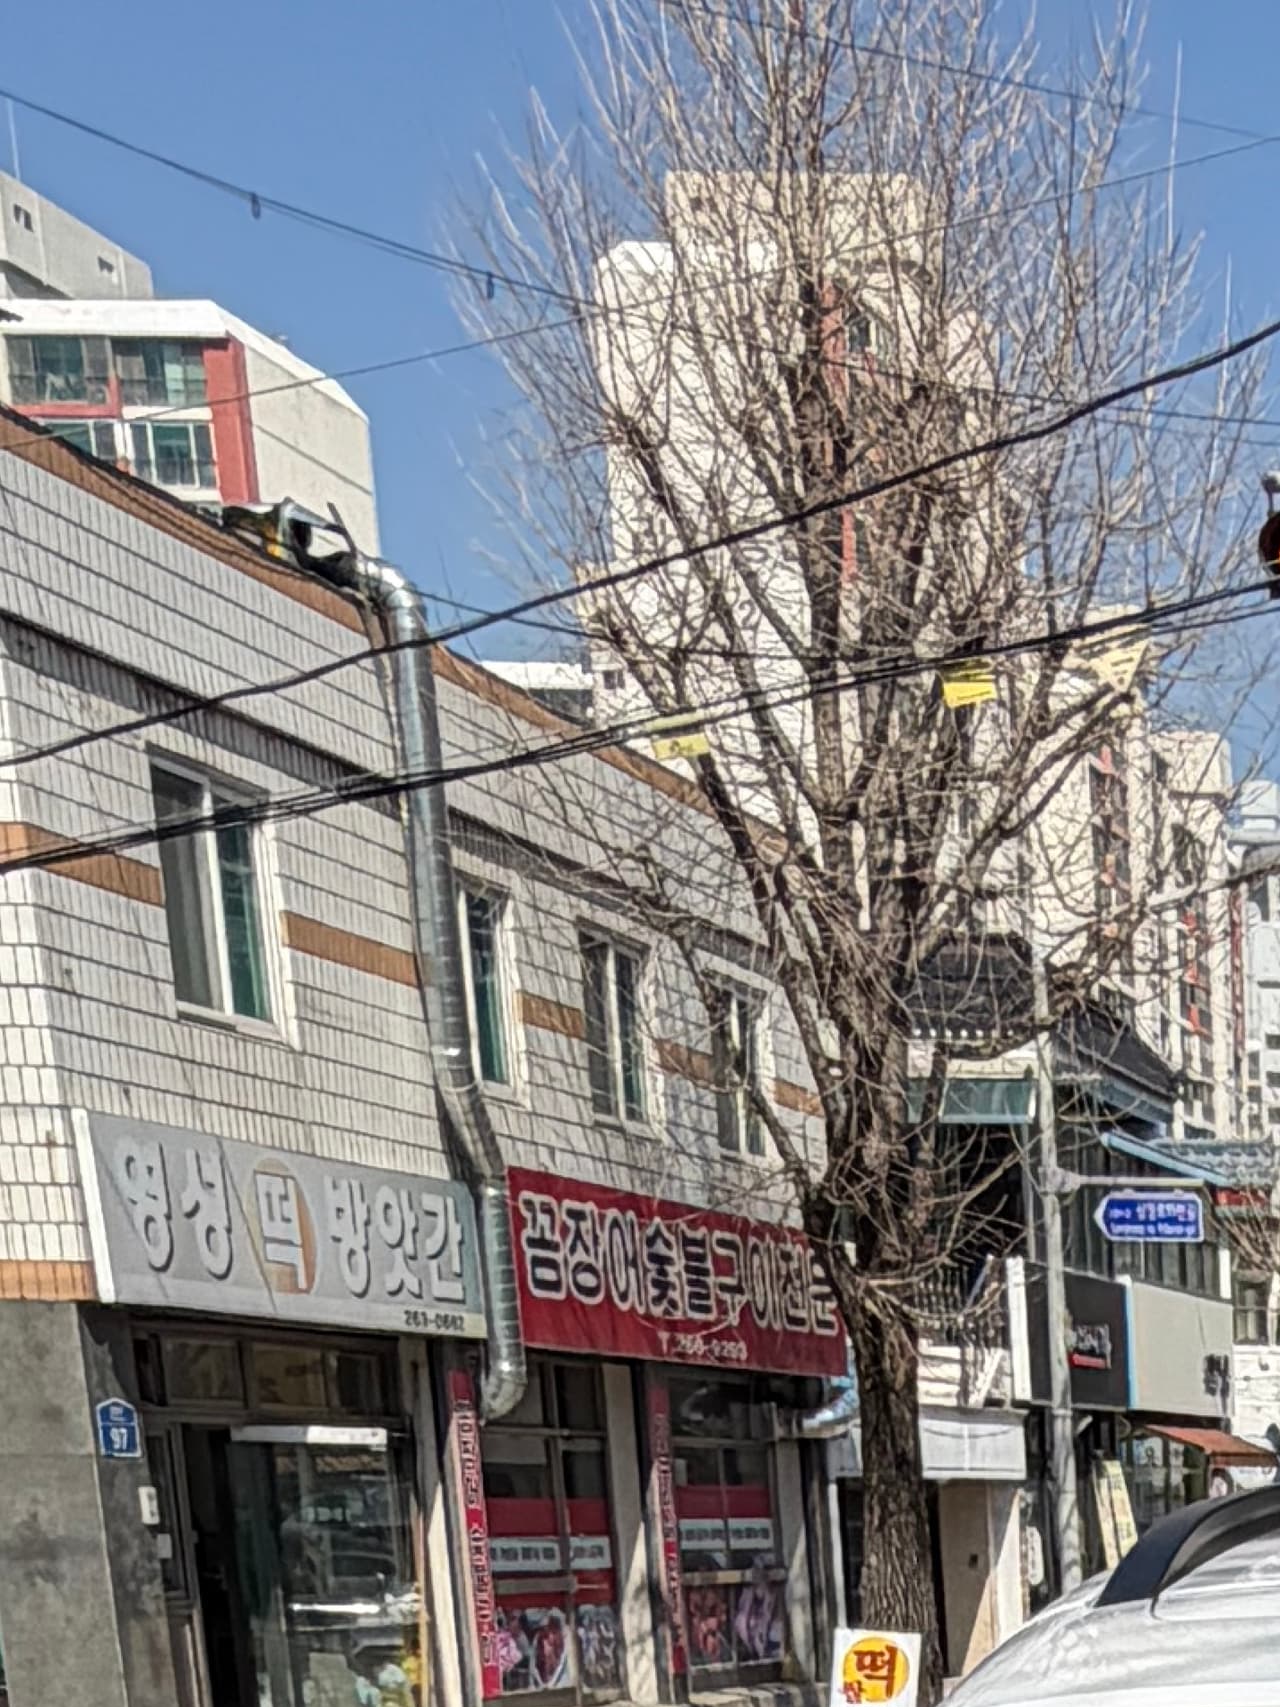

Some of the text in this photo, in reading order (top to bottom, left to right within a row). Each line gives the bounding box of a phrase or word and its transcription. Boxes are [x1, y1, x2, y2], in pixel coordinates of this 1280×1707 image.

[252, 1168, 314, 1297] 떡
[323, 1175, 467, 1303] 방앗간
[109, 1427, 128, 1451] 97
